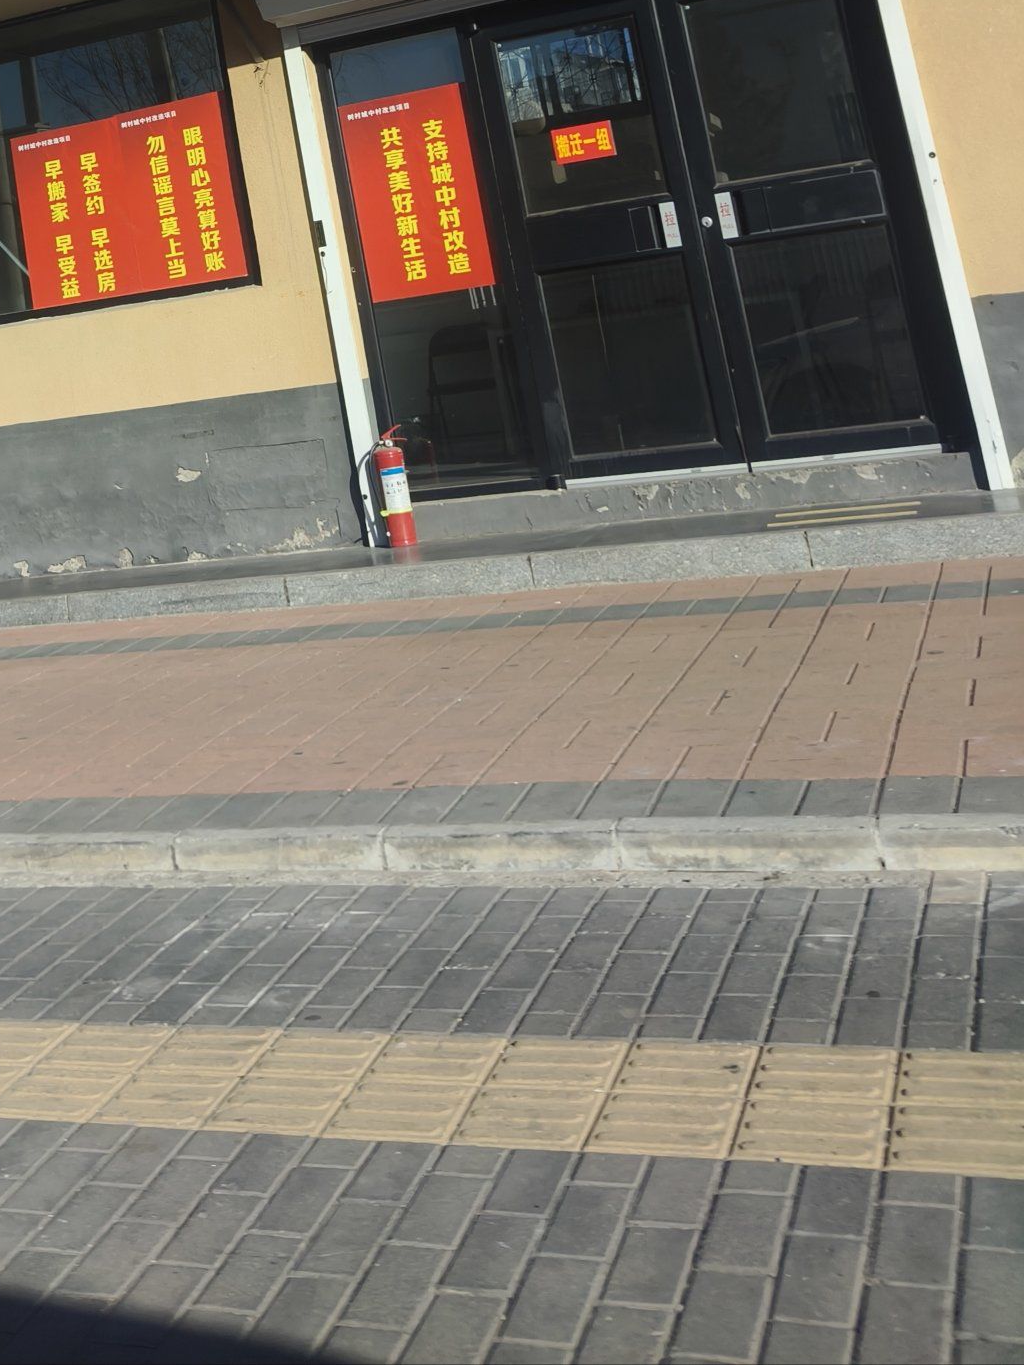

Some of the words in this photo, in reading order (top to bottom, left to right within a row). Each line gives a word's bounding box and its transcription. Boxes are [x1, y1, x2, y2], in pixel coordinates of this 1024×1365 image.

[555, 127, 612, 159] 搬迁一组
[44, 159, 70, 223] 早搬家
[79, 152, 105, 216] 早签约
[146, 135, 187, 280] 勿信谣言莫上当
[182, 126, 226, 273] 眼明心亮算好账
[380, 126, 427, 282] 共享美好新生活
[422, 119, 472, 276] 支持城中村改造
[55, 234, 81, 299] 早受益
[91, 227, 116, 294] 早选房
